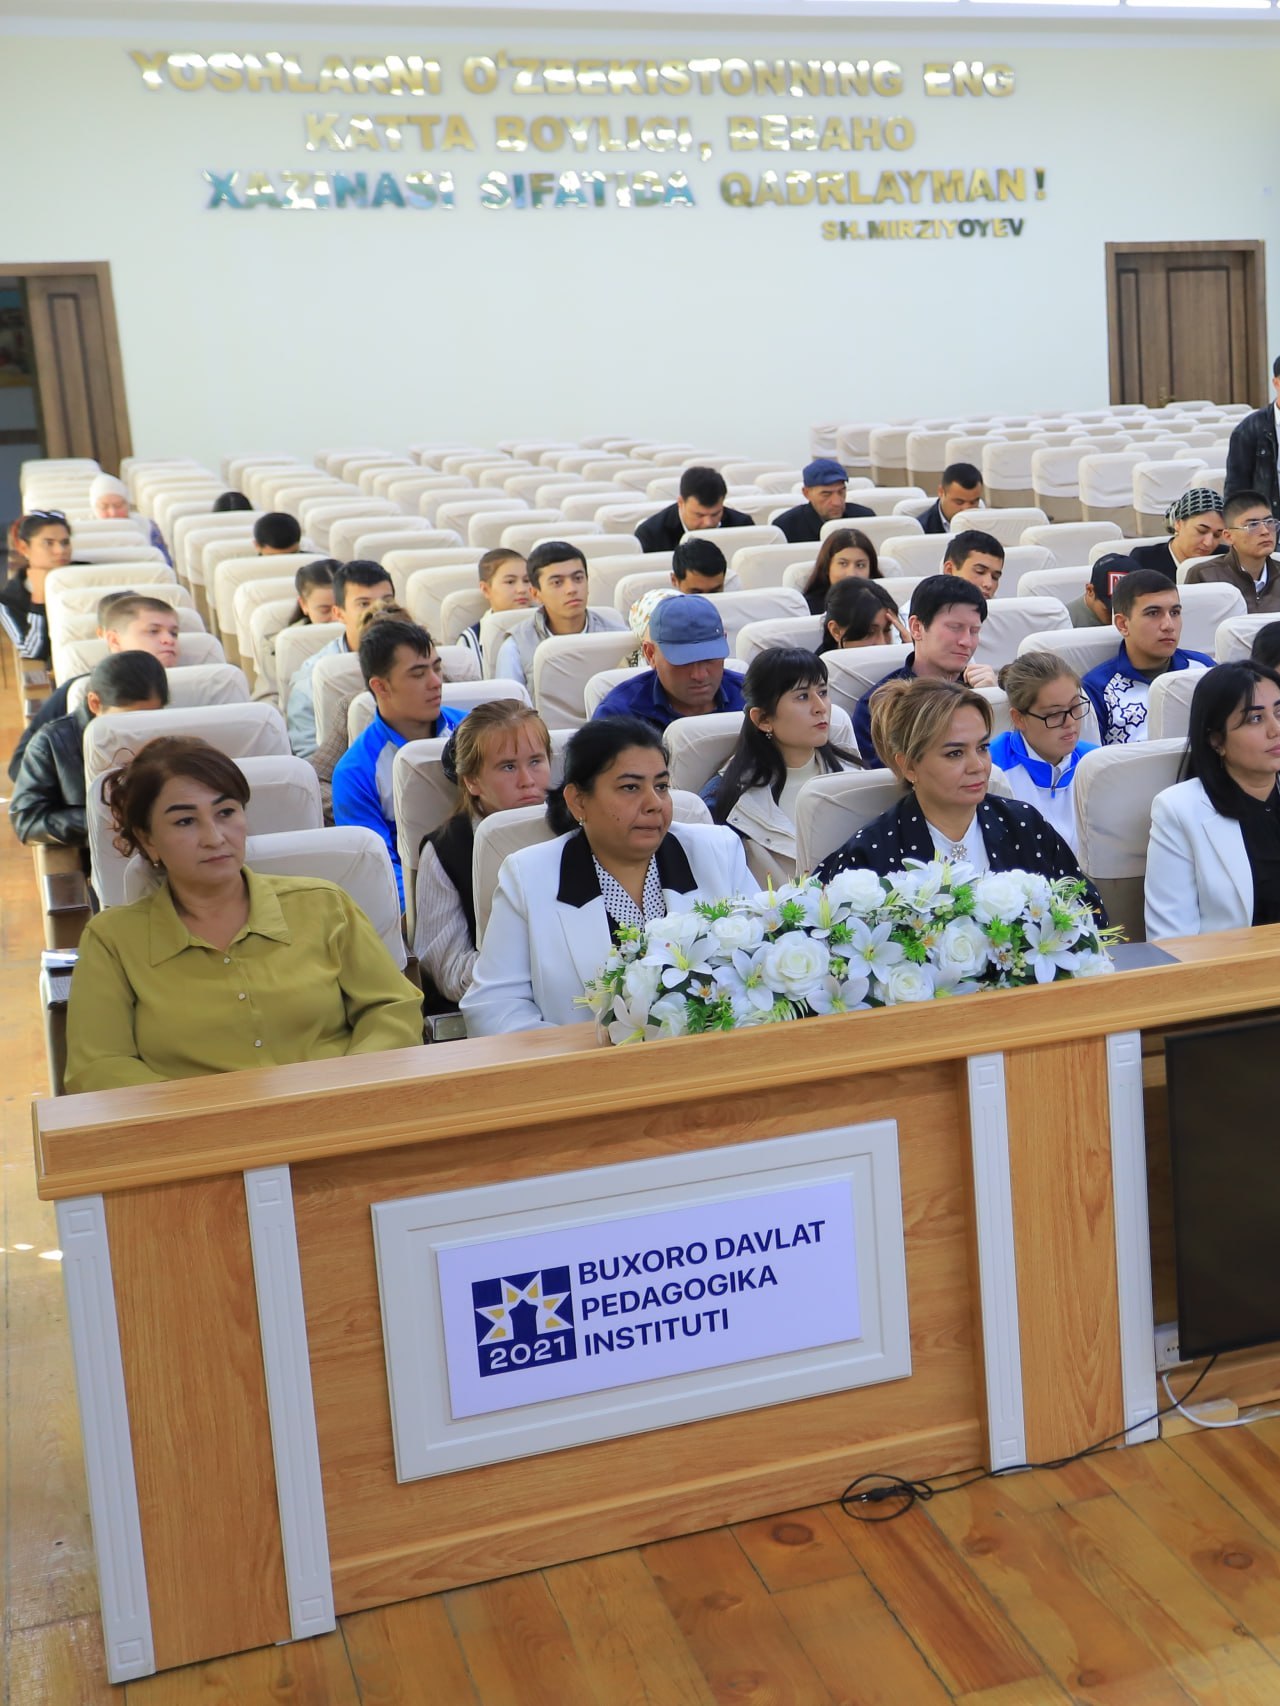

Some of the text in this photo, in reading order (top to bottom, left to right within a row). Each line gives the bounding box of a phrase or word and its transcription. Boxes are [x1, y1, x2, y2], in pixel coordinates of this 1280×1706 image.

[130, 51, 443, 96] YOSHLARNI
[923, 60, 1015, 98] ENG
[305, 113, 916, 162] KATTA BOYLIGI, BEBAHO
[202, 170, 455, 210] XAZINASI
[480, 170, 695, 209] SIFATIDA
[821, 217, 1025, 240] SH.MIRZIYOYEV
[578, 1220, 827, 1286] BUXORO DAVLAT
[581, 1264, 778, 1321] PEDAGOGIKA
[489, 1335, 568, 1371] 2021
[584, 1308, 730, 1357] INSTITUTI
